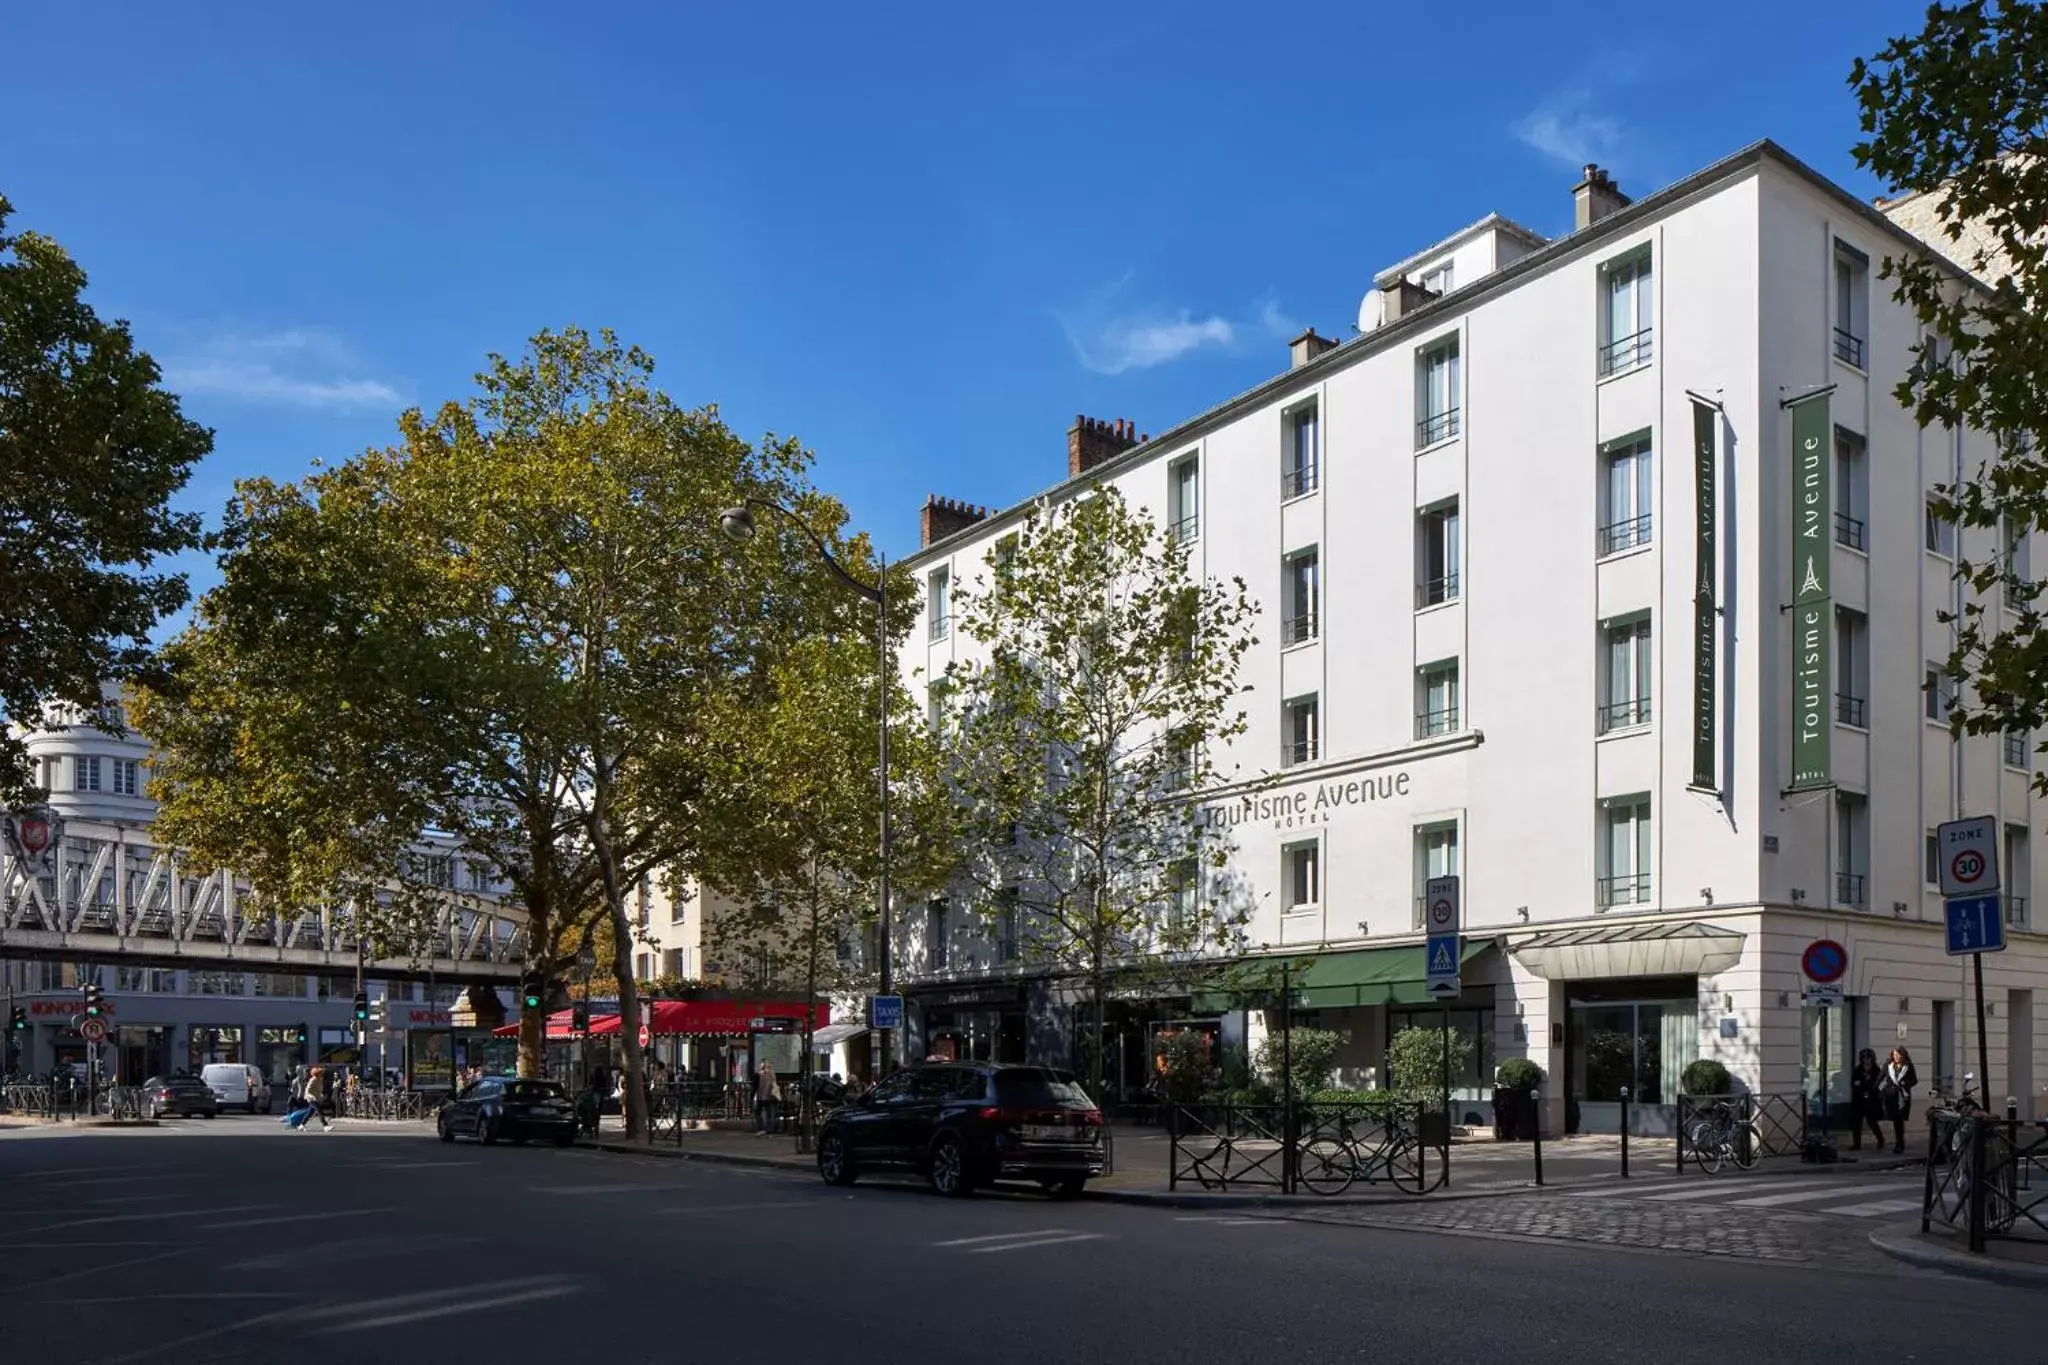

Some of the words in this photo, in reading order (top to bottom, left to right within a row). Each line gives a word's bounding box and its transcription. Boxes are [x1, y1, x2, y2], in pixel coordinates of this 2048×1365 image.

[1803, 436, 1819, 539] Avenue
[1799, 611, 1820, 743] Tourisme
[1203, 793, 1306, 829] Tourisme
[1314, 772, 1409, 811] Avenue
[1950, 828, 1983, 842] ZONE
[1958, 858, 1979, 875] 30
